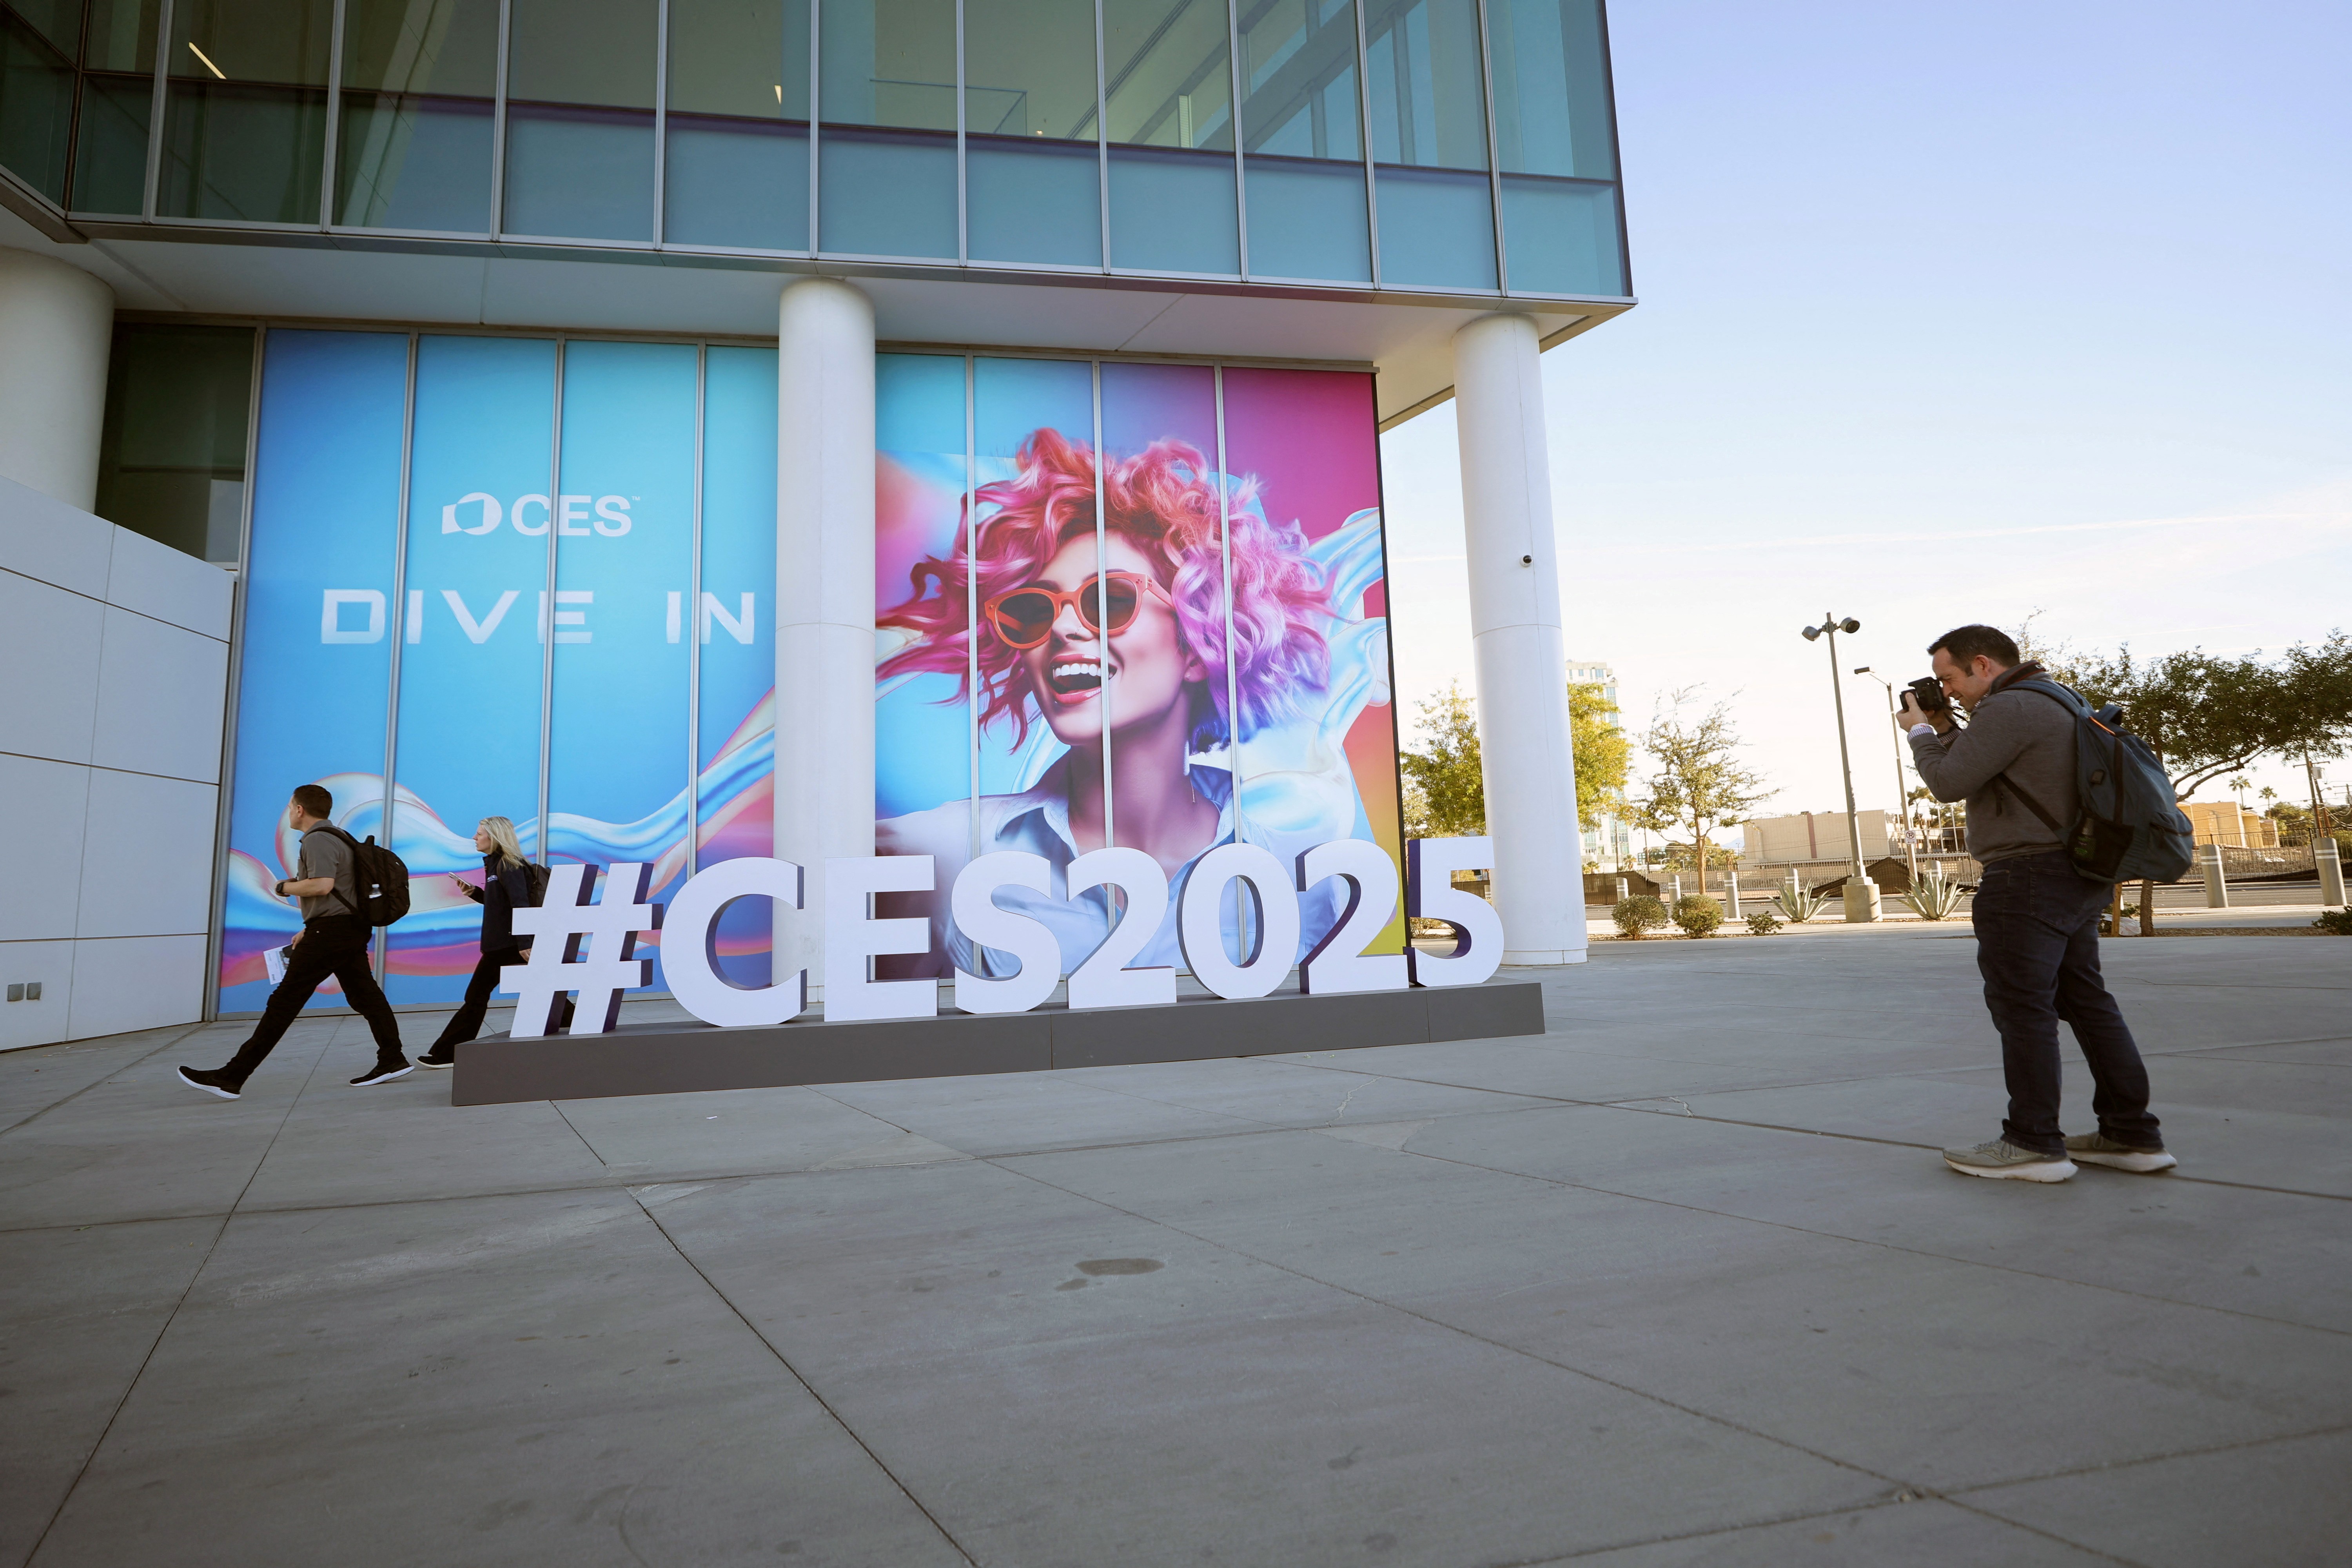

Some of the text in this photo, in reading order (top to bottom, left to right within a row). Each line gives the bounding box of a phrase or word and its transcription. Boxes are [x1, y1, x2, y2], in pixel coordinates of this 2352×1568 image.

[511, 494, 632, 537] CES
[320, 588, 755, 644] DIVE IN
[499, 835, 1504, 1038] #CES2025
